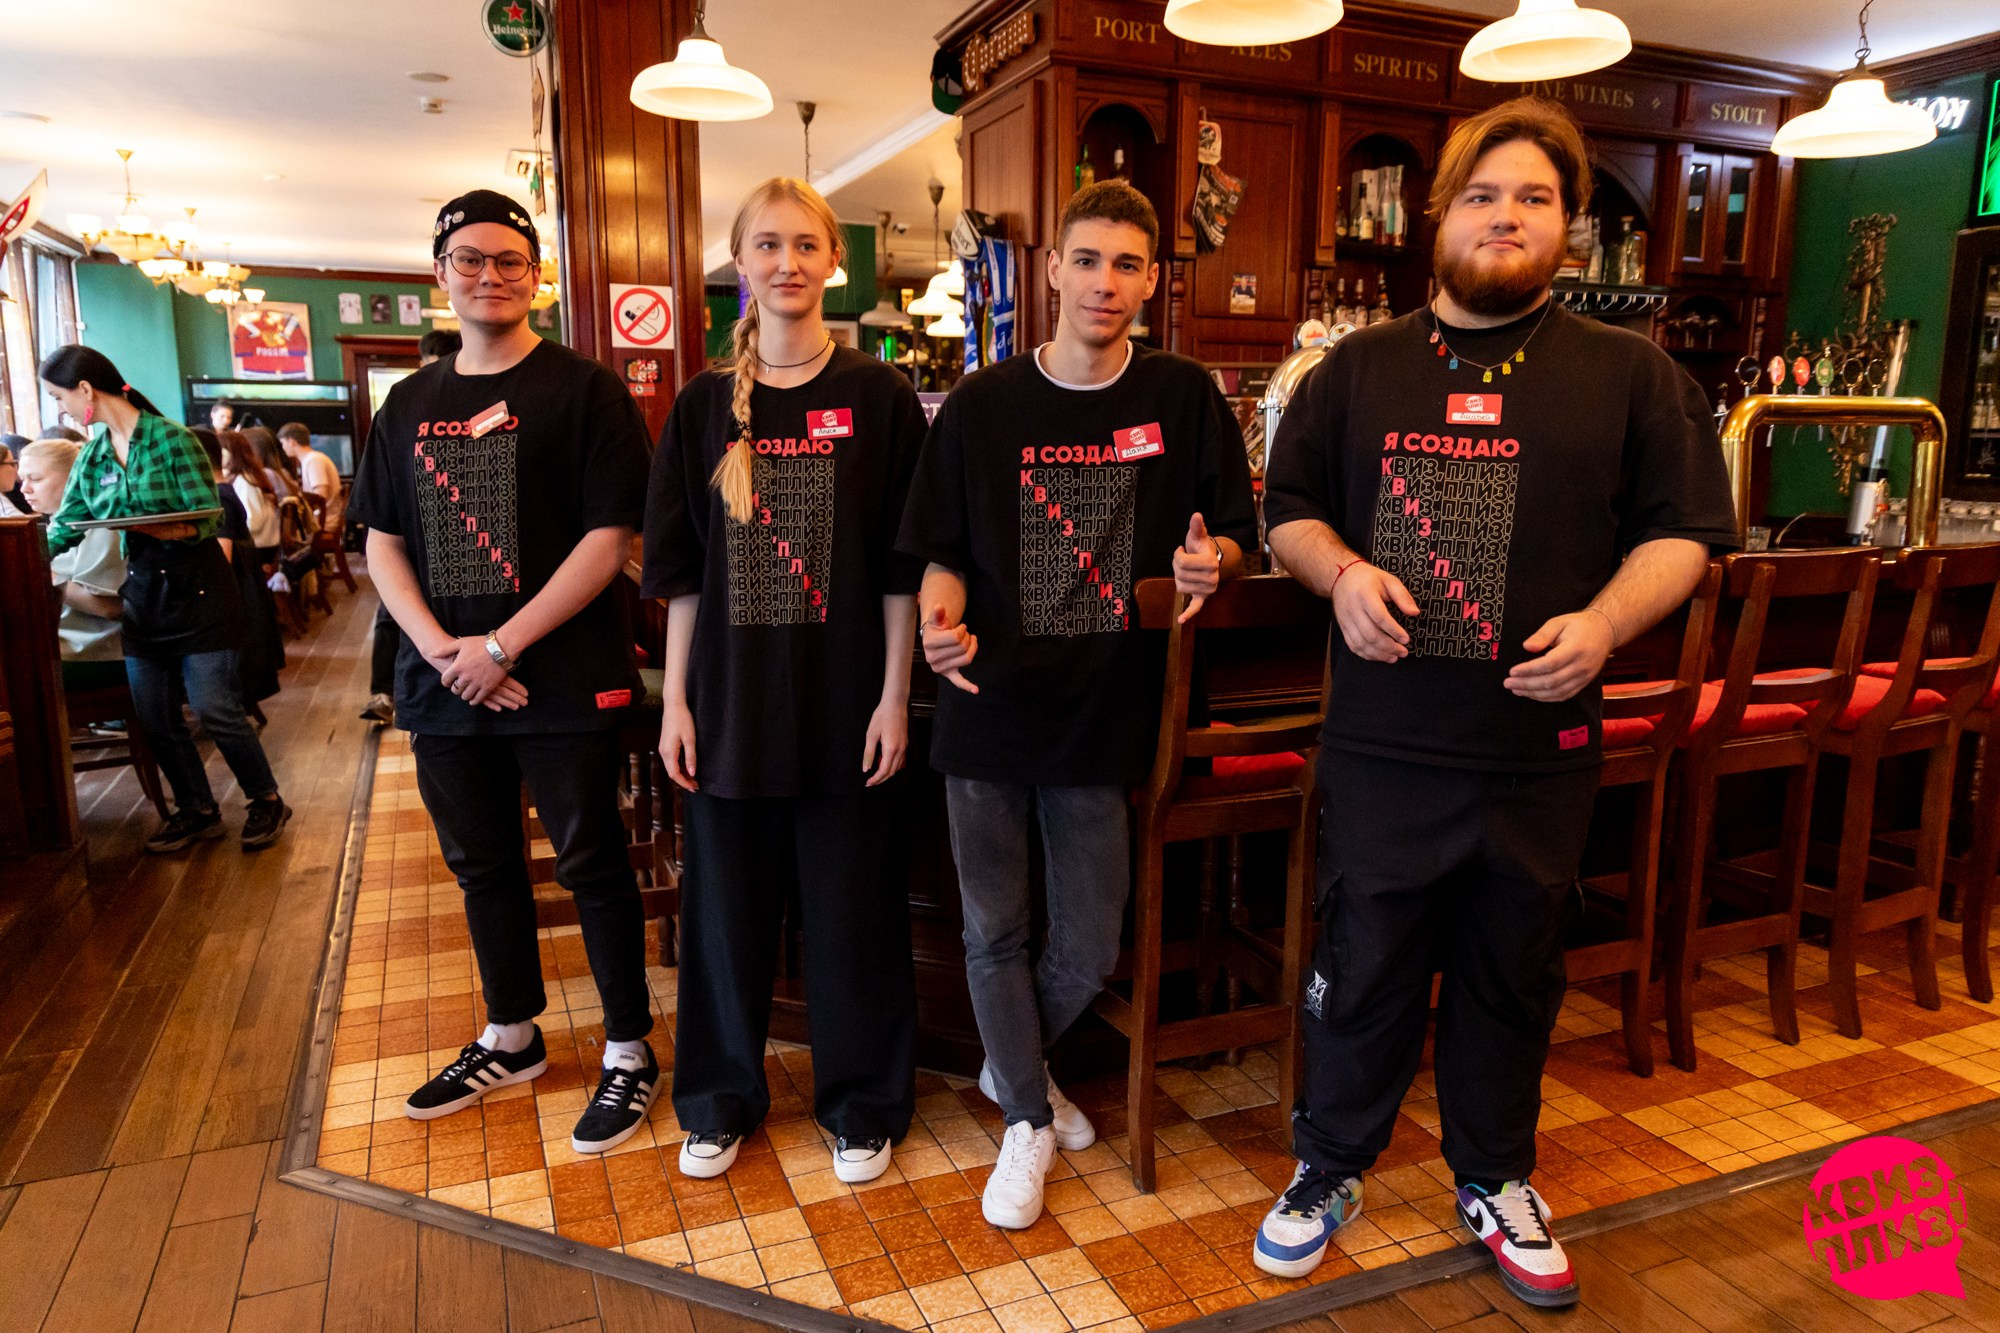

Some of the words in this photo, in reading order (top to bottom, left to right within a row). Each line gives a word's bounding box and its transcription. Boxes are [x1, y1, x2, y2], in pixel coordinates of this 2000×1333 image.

[1094, 17, 1161, 44] PORT
[1354, 53, 1438, 82] SPIRITS
[1573, 83, 1634, 108] WINES
[1711, 102, 1767, 125] STOUT
[417, 421, 430, 437] Я
[432, 415, 519, 437] СОЗЮ
[749, 438, 834, 457] ОЗДАЮ
[1021, 447, 1035, 464] Я
[1040, 445, 1117, 465] СОЗДА
[1383, 432, 1399, 450] Я
[1403, 432, 1520, 460] СОЗДАЮ
